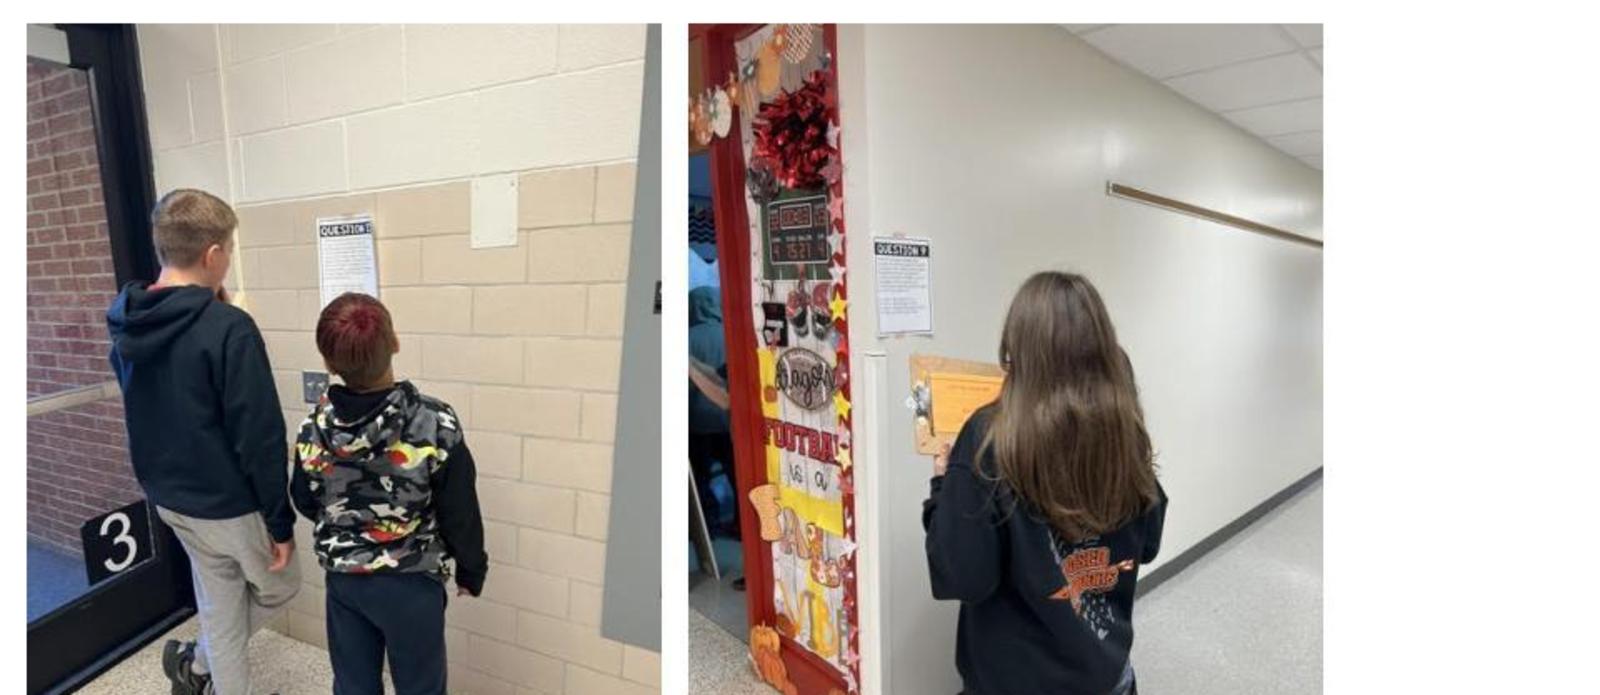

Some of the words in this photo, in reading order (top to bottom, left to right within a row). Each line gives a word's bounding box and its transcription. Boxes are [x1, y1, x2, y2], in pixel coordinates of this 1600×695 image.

[321, 223, 364, 236] QUESTION
[877, 241, 919, 256] QUESTION
[100, 511, 138, 573] 3
